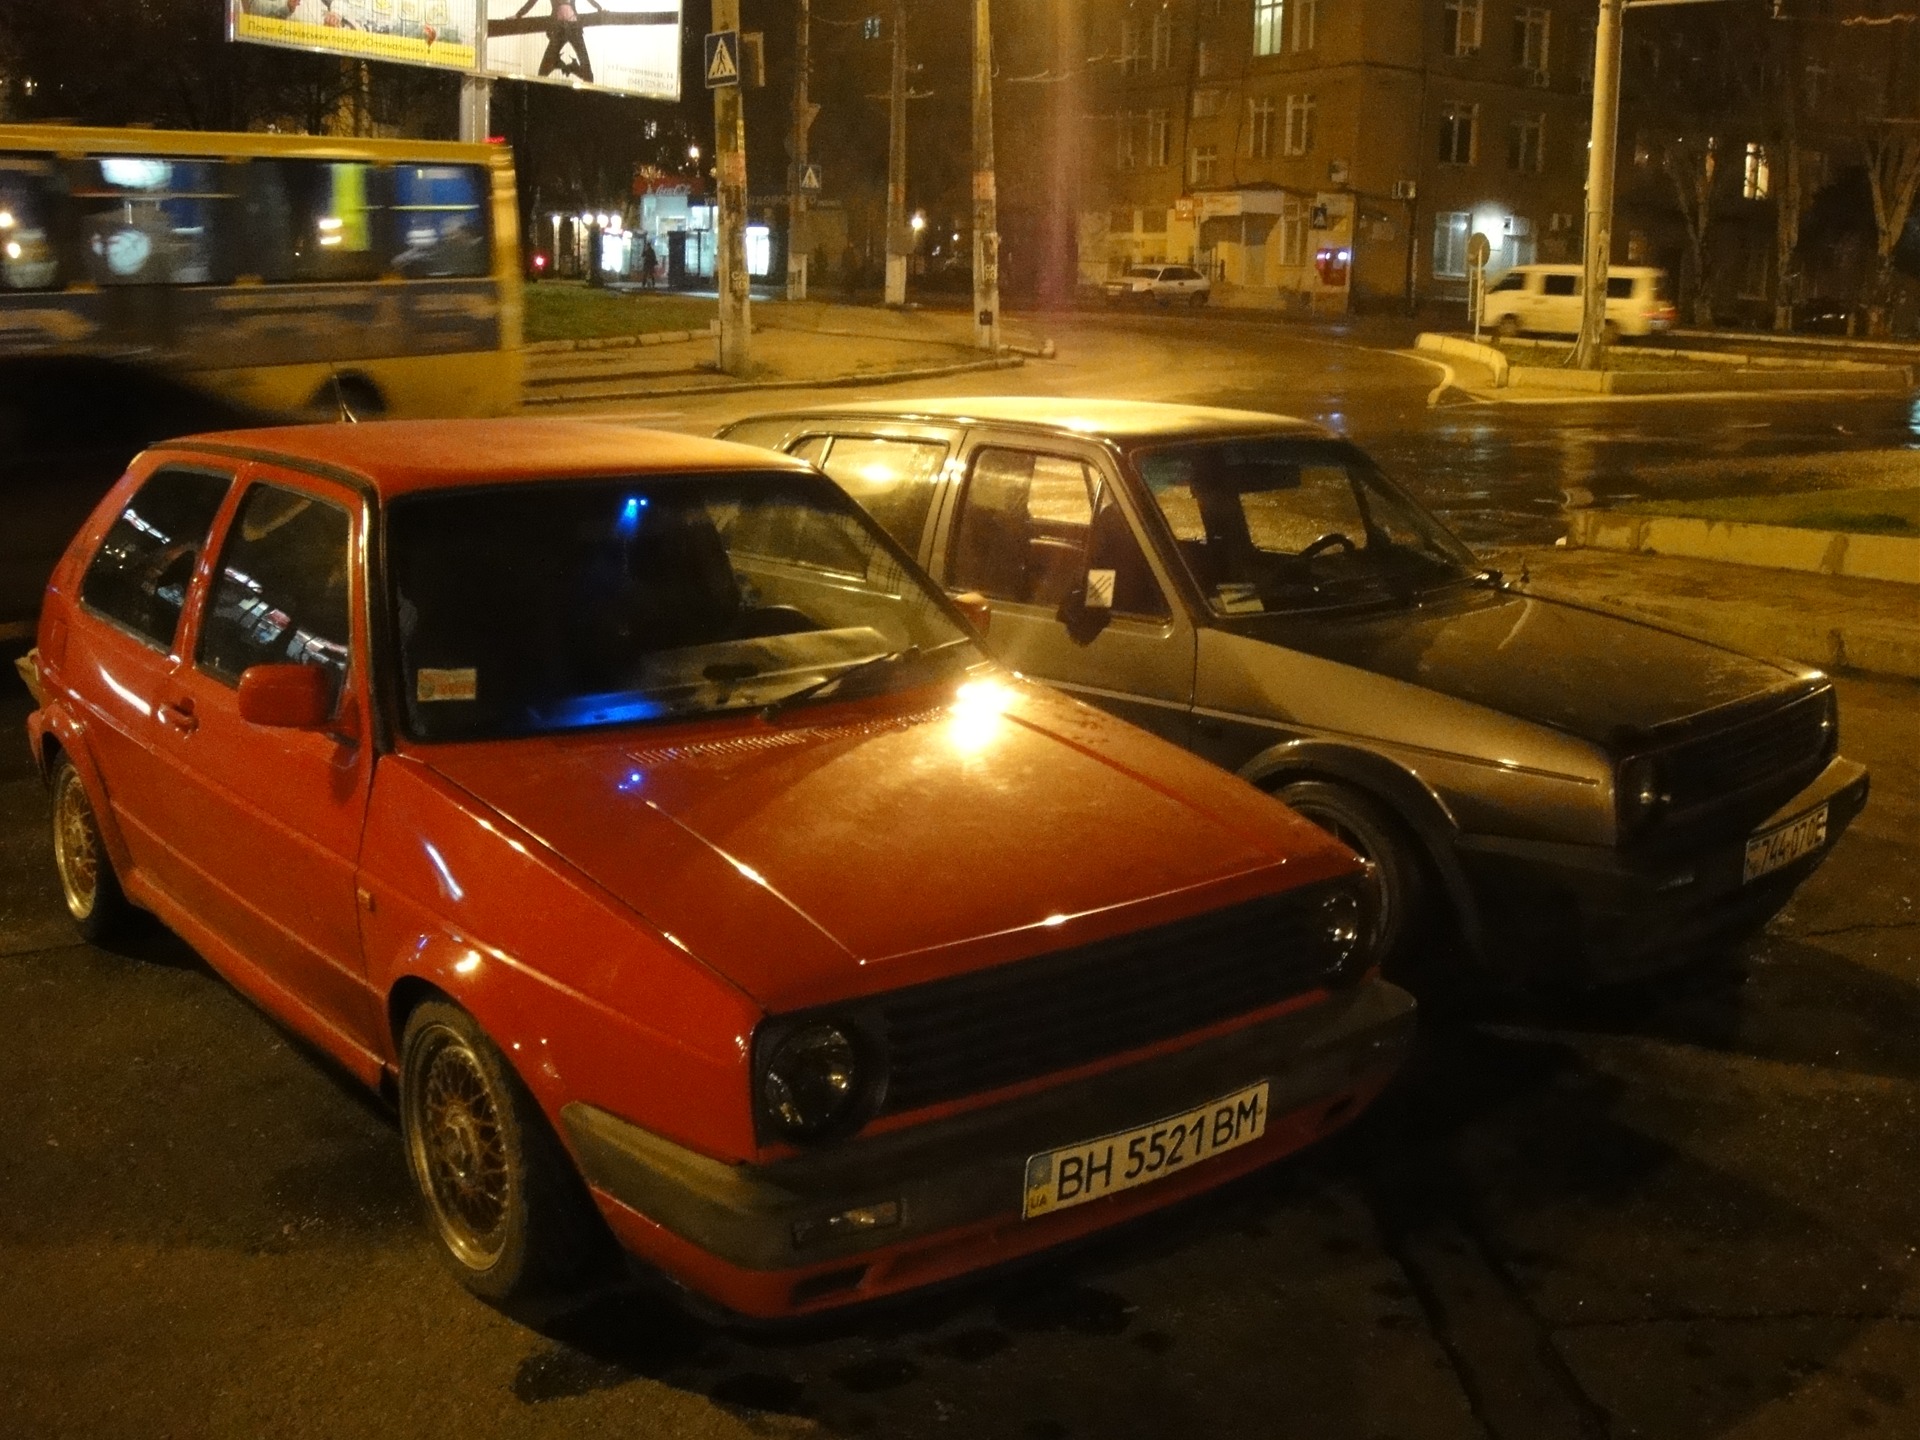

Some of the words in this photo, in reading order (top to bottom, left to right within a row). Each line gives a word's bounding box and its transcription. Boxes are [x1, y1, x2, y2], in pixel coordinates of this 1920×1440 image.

[1057, 1146, 1113, 1202] BH
[1124, 1116, 1205, 1179] 5521
[1211, 1093, 1259, 1148] BM
